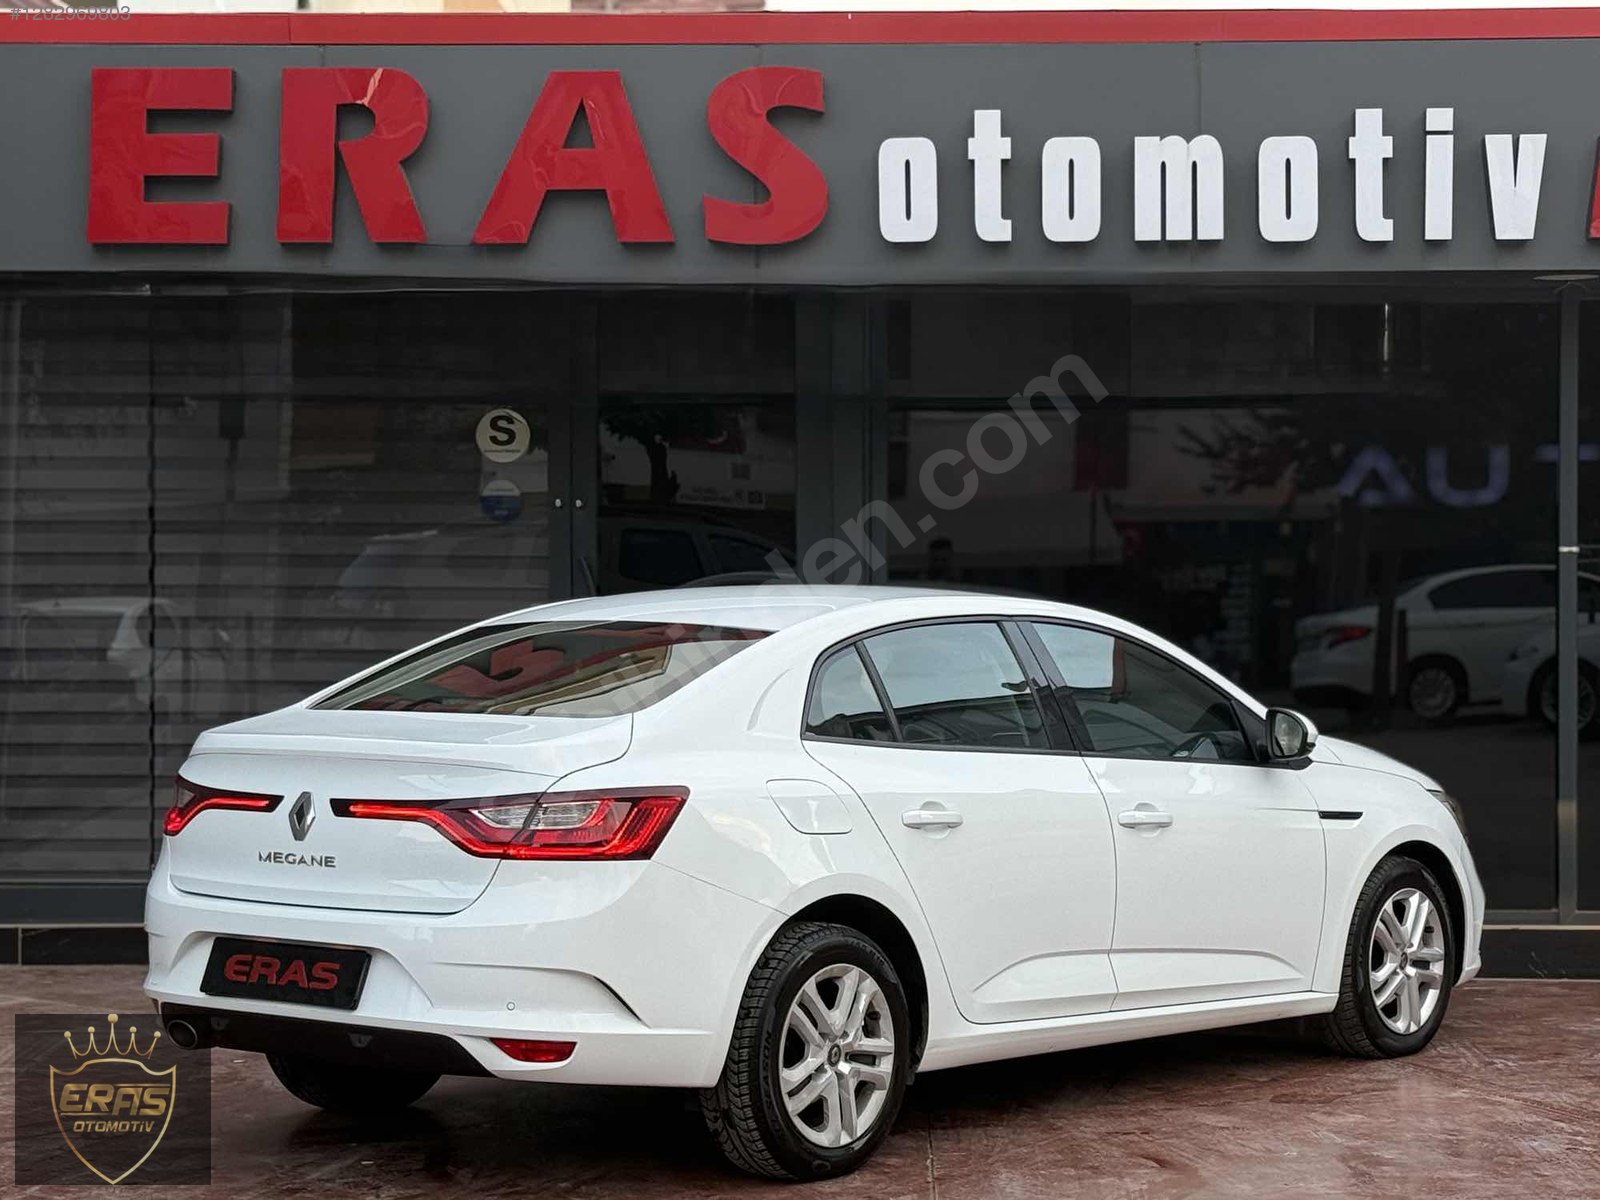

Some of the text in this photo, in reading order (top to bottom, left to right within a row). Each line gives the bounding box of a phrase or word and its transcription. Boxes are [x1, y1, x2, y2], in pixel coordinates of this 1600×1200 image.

[87, 67, 829, 245] ERAS
[878, 107, 1548, 243] otomotiv
[489, 415, 516, 447] S
[258, 851, 336, 868] MEGANE
[224, 953, 341, 991] ERAS
